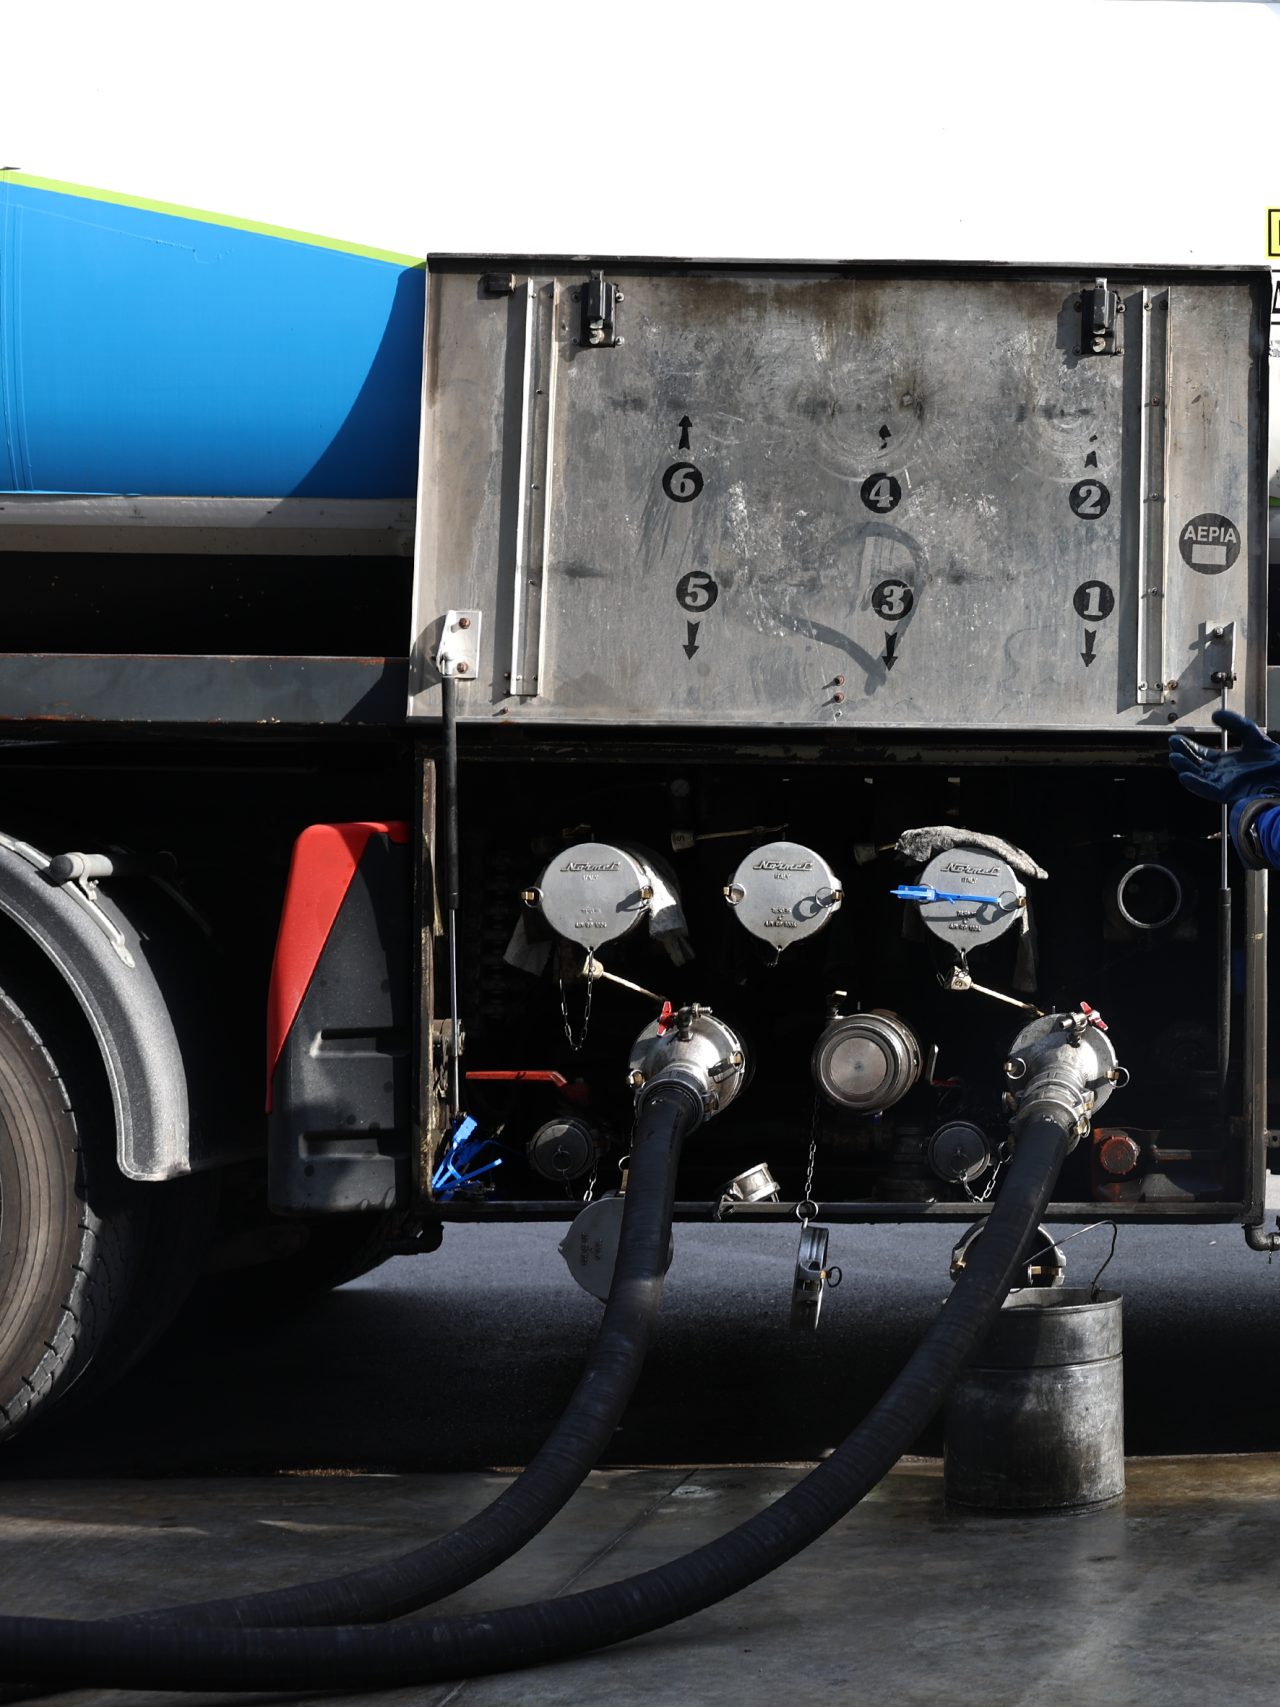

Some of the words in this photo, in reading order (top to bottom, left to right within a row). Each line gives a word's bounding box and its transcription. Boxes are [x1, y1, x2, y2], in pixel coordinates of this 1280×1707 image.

[670, 468, 695, 497] 6
[869, 478, 894, 507] 4
[1077, 485, 1101, 514] 2
[1184, 525, 1237, 544] ΑΕΡΙΑ
[685, 577, 709, 606] 5
[881, 585, 904, 615] 3
[1084, 586, 1103, 616] 1
